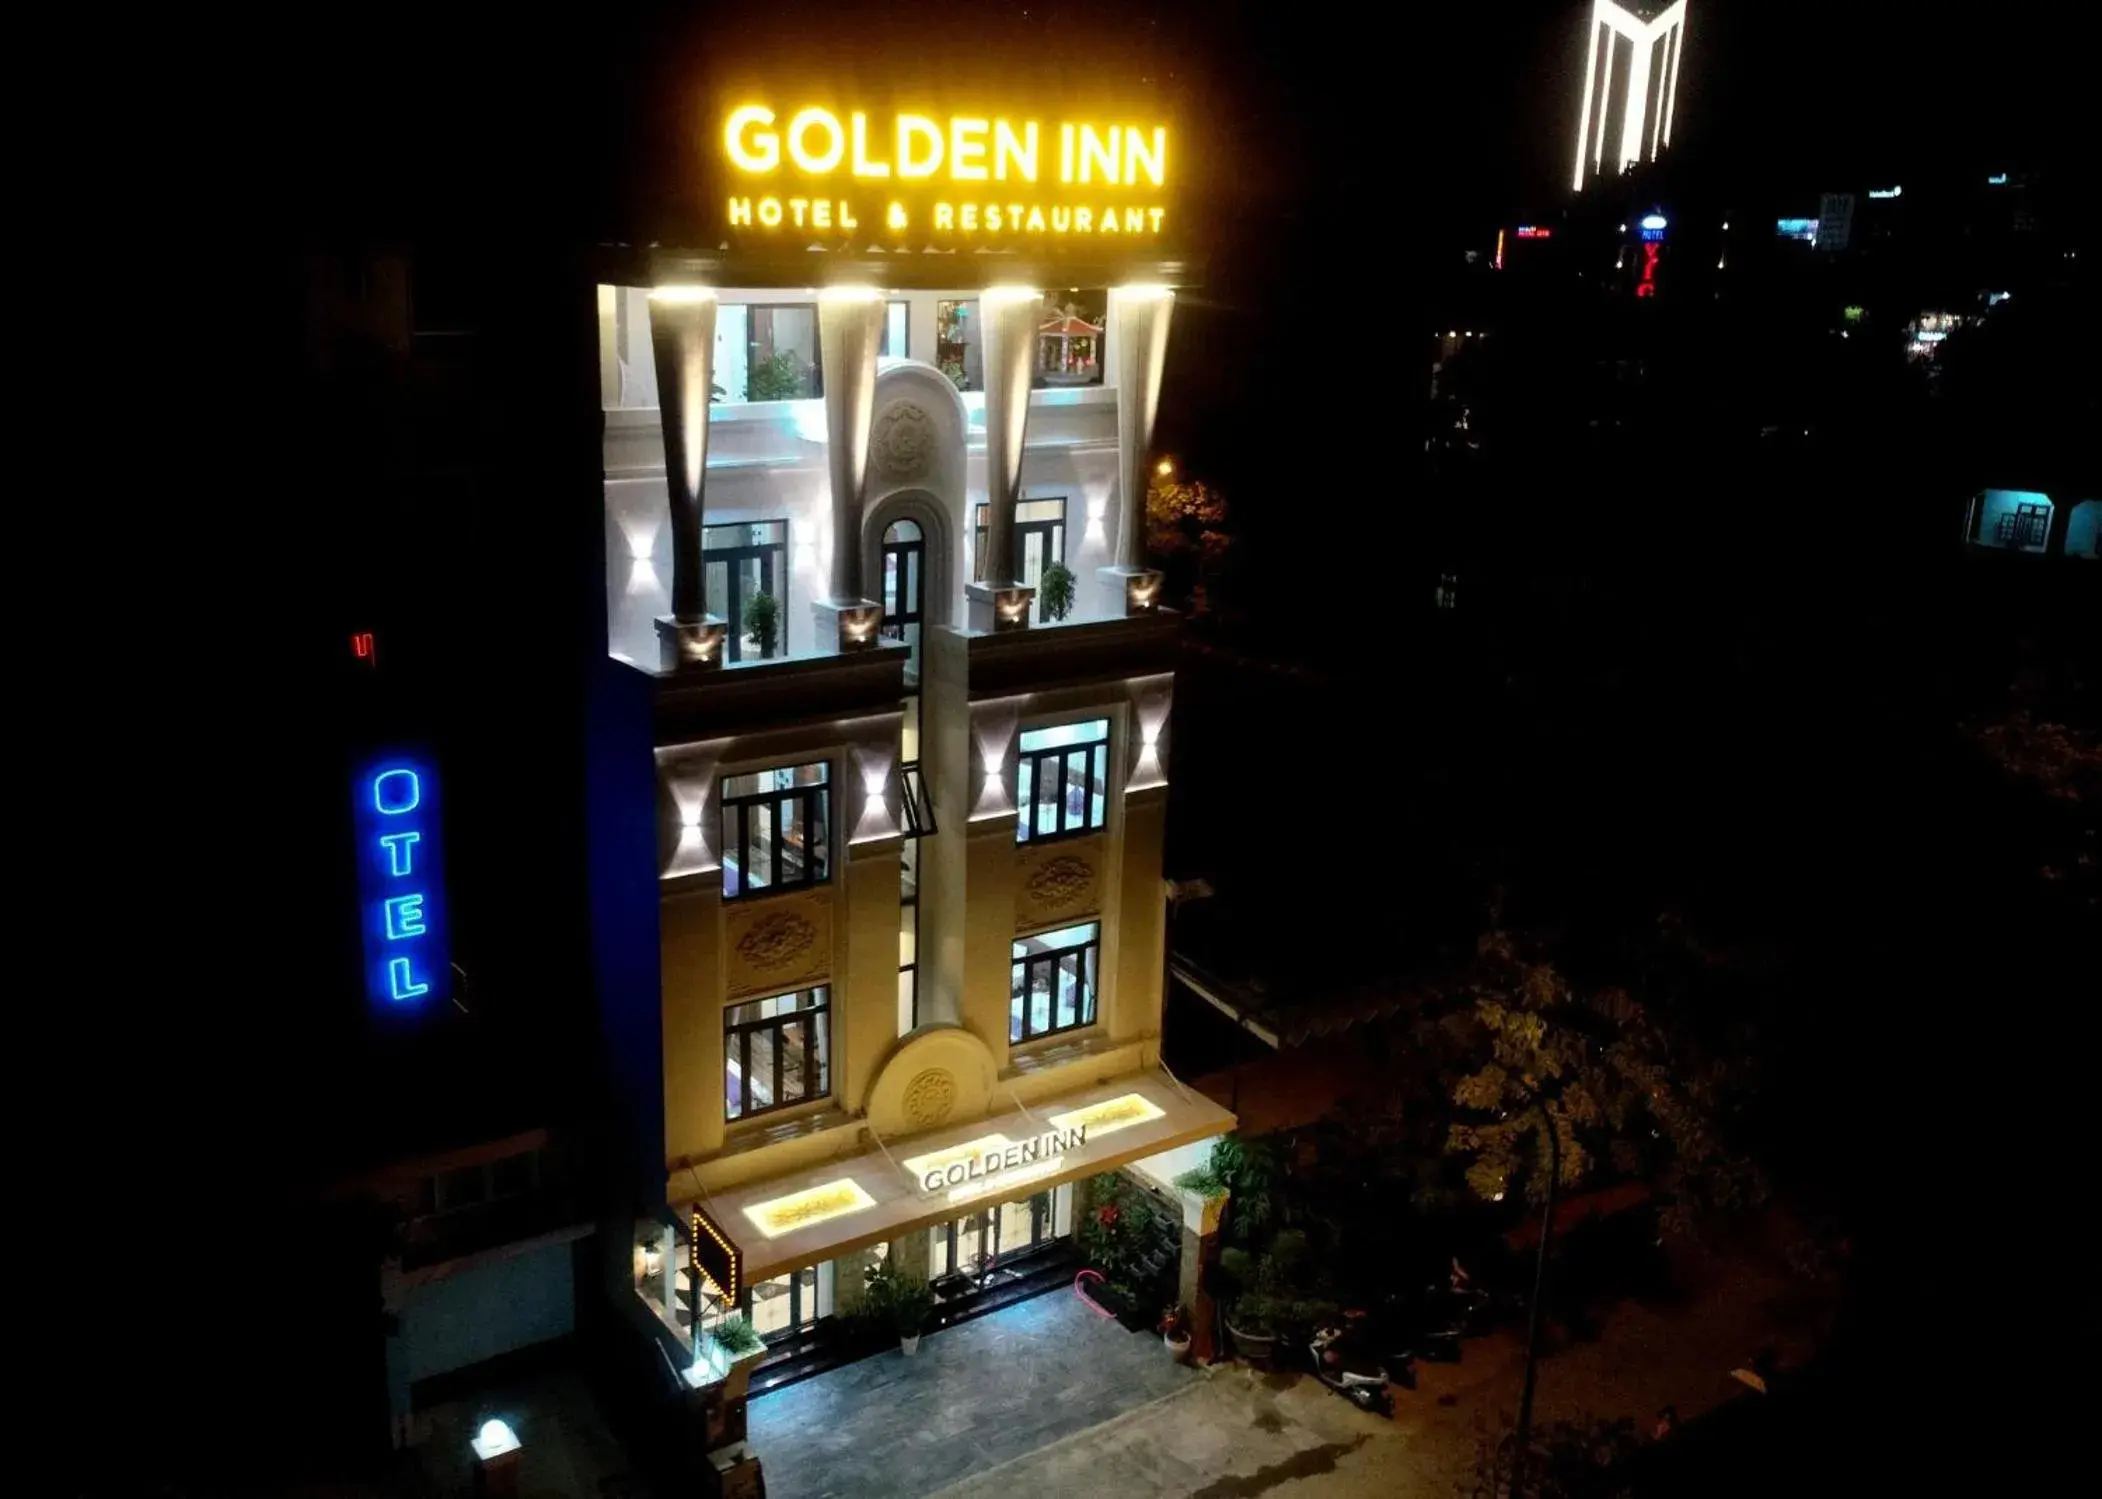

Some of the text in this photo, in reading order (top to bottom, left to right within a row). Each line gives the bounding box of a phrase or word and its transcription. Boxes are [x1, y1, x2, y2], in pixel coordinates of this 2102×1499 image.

[725, 106, 1167, 186] GOLDEN INN
[729, 198, 1164, 232] HOTEL & RESTAURANT
[374, 769, 429, 1000] OTEL
[924, 1124, 1087, 1191] GOLDEN INN
